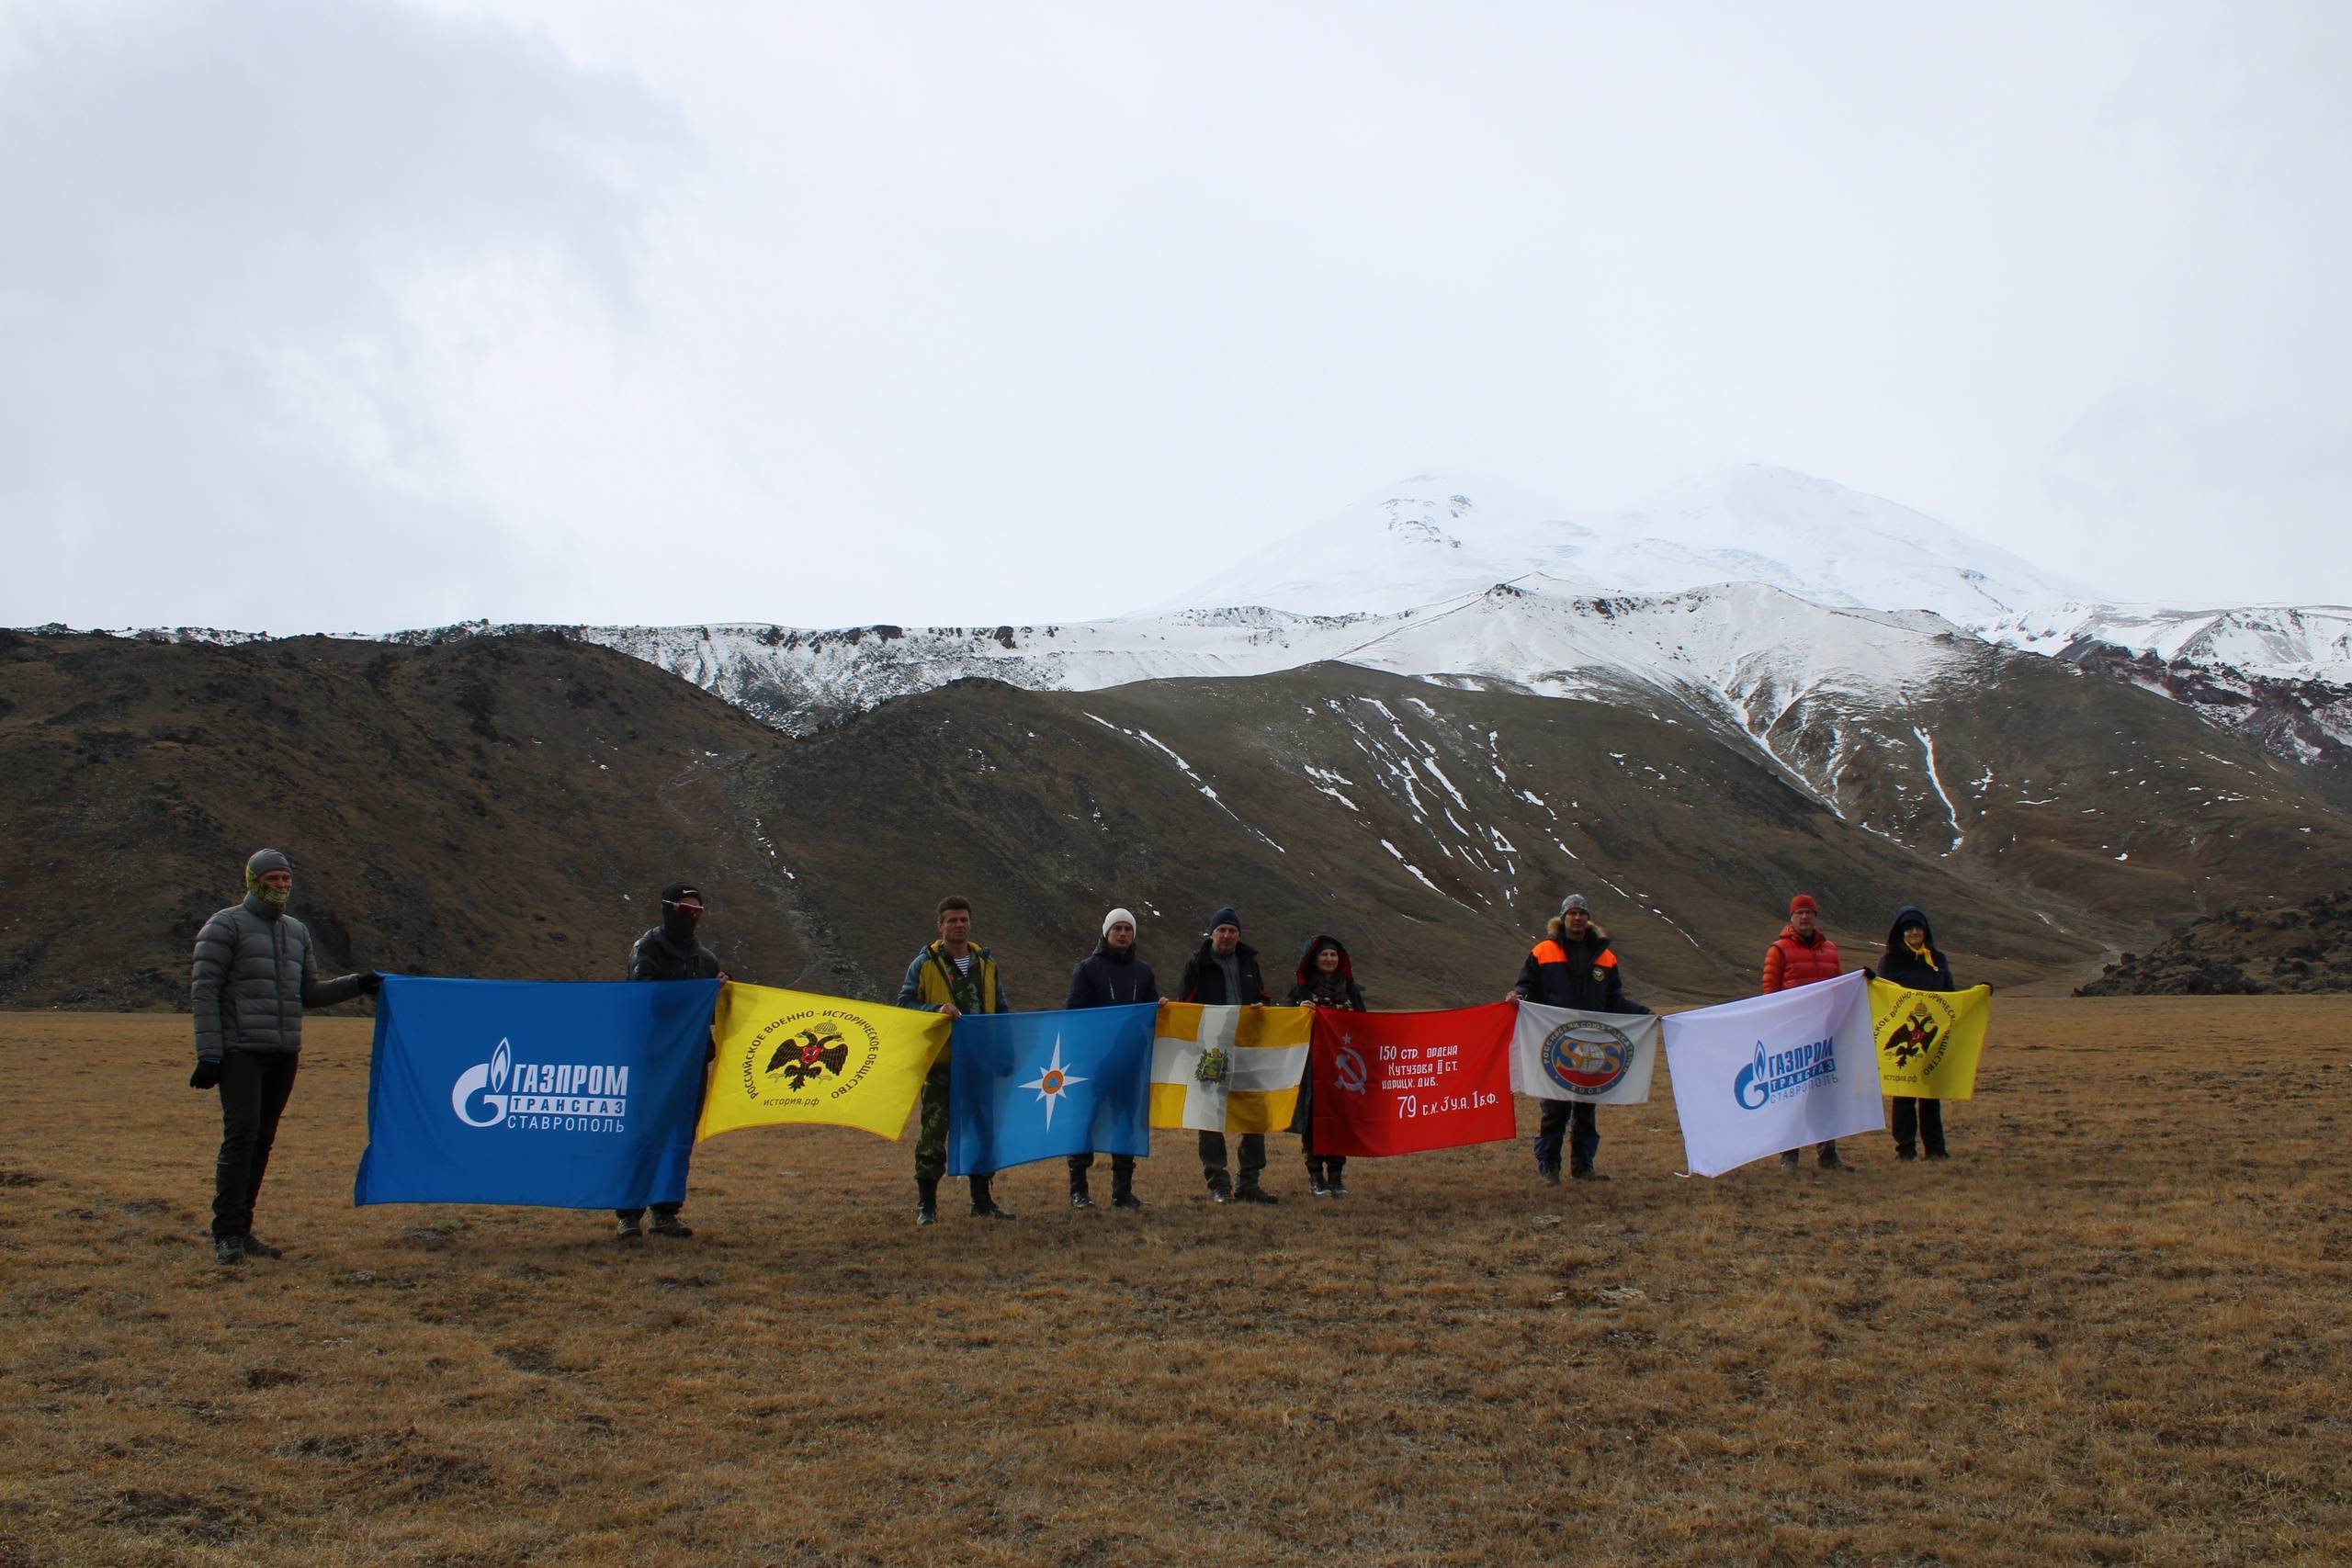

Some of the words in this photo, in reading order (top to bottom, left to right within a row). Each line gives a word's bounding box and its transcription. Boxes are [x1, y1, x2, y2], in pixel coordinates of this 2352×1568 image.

[1379, 1045, 1396, 1061] 150
[1427, 1045, 1458, 1058] ОРДЕНА
[1769, 1036, 1833, 1078] ГАЗПРОМ
[742, 1033, 765, 1100] РОССИЙСКОЕ
[831, 1054, 877, 1099] ОБЩЕСТВО
[1770, 1060, 1834, 1090] ТРАНСГАЗ
[512, 1064, 629, 1096] ГАЗПРОМ
[1418, 1077, 1439, 1088] ДИВ.
[1770, 1074, 1838, 1104] СТАВРОПОЛЬ
[512, 1098, 624, 1113] ТРАНСГАЗ
[763, 1098, 820, 1107] история.рф
[1396, 1095, 1417, 1119] 79
[507, 1115, 625, 1133] СТАВРОПОЛЬ
